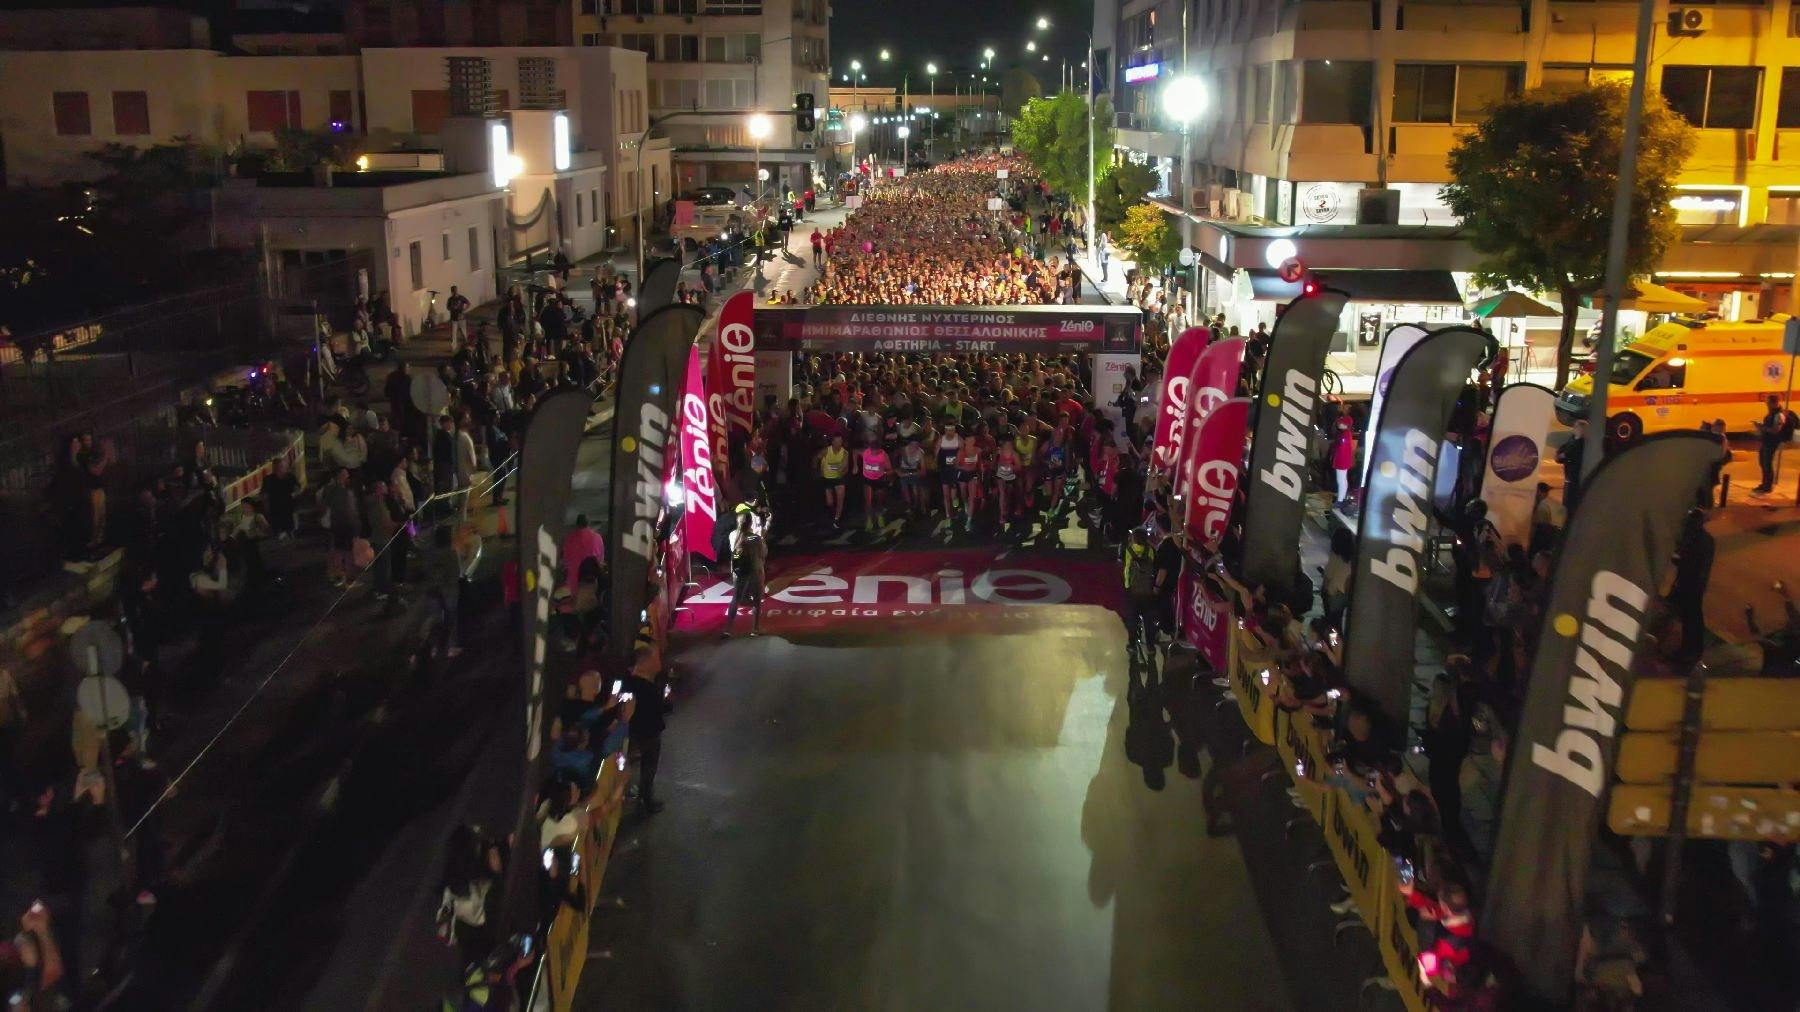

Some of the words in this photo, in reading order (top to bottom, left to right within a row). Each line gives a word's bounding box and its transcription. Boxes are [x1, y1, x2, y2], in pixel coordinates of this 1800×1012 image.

[801, 324, 930, 337] ΗΜΙΜΑΡΑΘΩΝΙΟΣ
[934, 326, 1048, 339] ΘΕΣΣΑΛΟΝΙΚΗΣ
[850, 313, 917, 323] ΔΙΕΘΝΗΣ
[922, 313, 1016, 324] ΝΥΧΤΕΡΙΝΟΣ
[874, 340, 941, 350] ΑΦΕΤΗΡΙΑ
[955, 340, 997, 351] START
[621, 402, 668, 562] bwin
[1261, 368, 1316, 502] bwin
[1371, 428, 1438, 596] bwin
[1532, 570, 1649, 798] bwin
